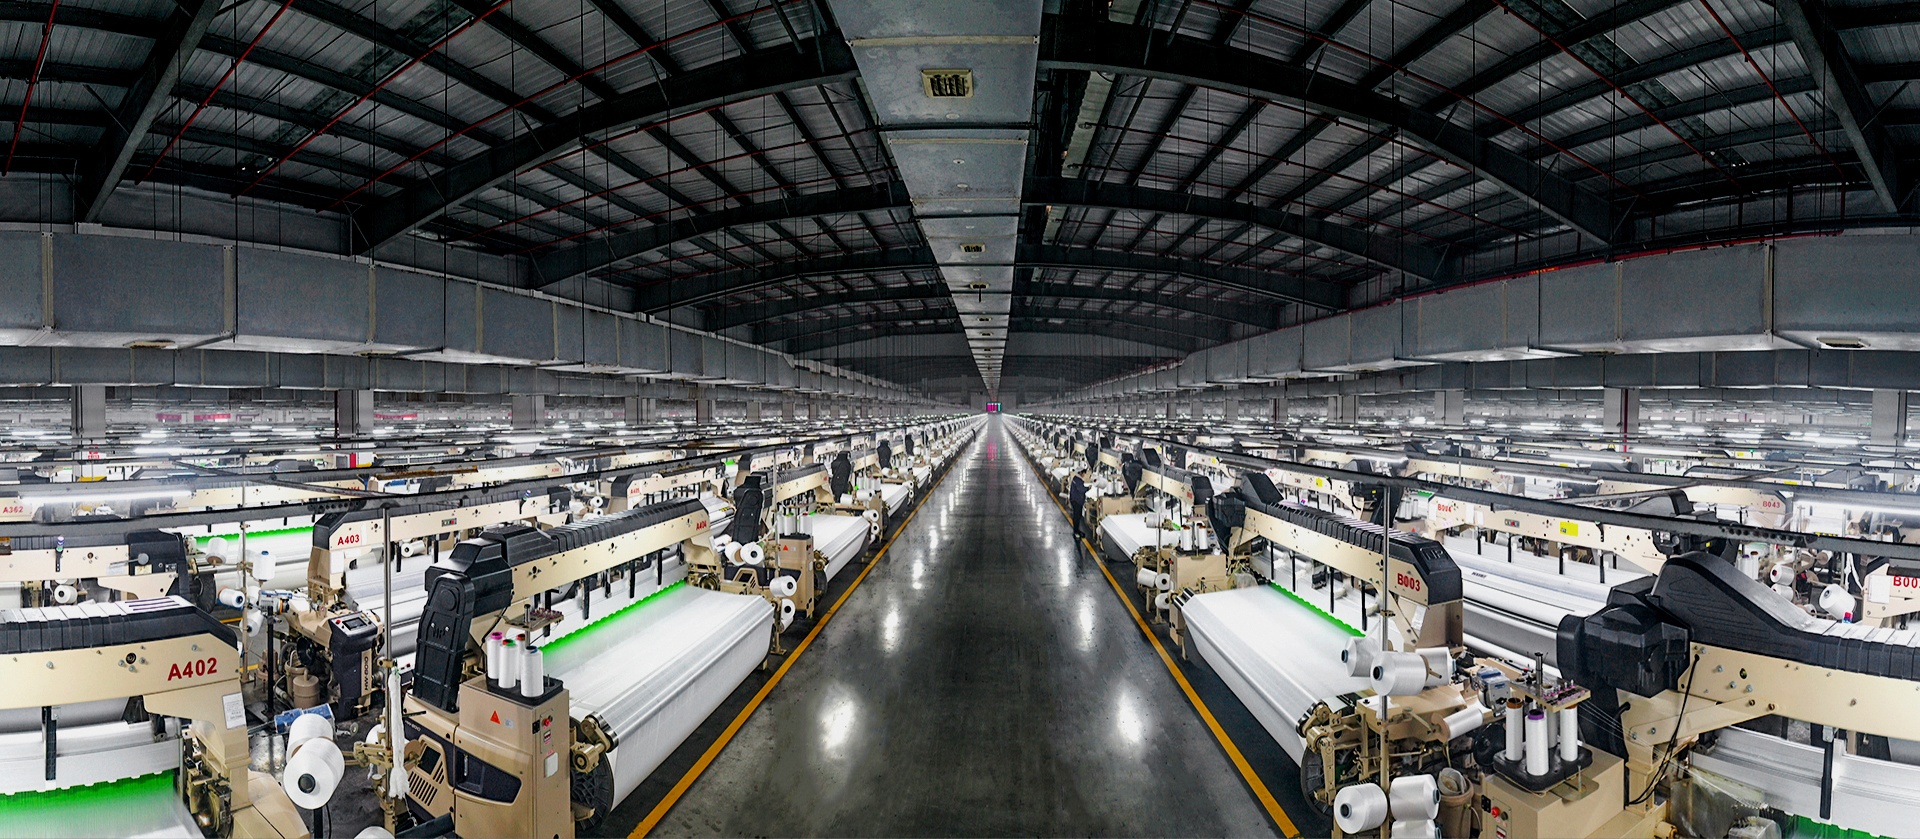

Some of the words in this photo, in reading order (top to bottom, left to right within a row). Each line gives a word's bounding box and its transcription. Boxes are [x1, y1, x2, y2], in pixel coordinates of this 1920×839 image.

[3, 506, 24, 514] A362
[337, 534, 360, 546] A403
[1397, 572, 1421, 592] B003
[1893, 575, 1920, 589] B00
[167, 657, 218, 682] A402
